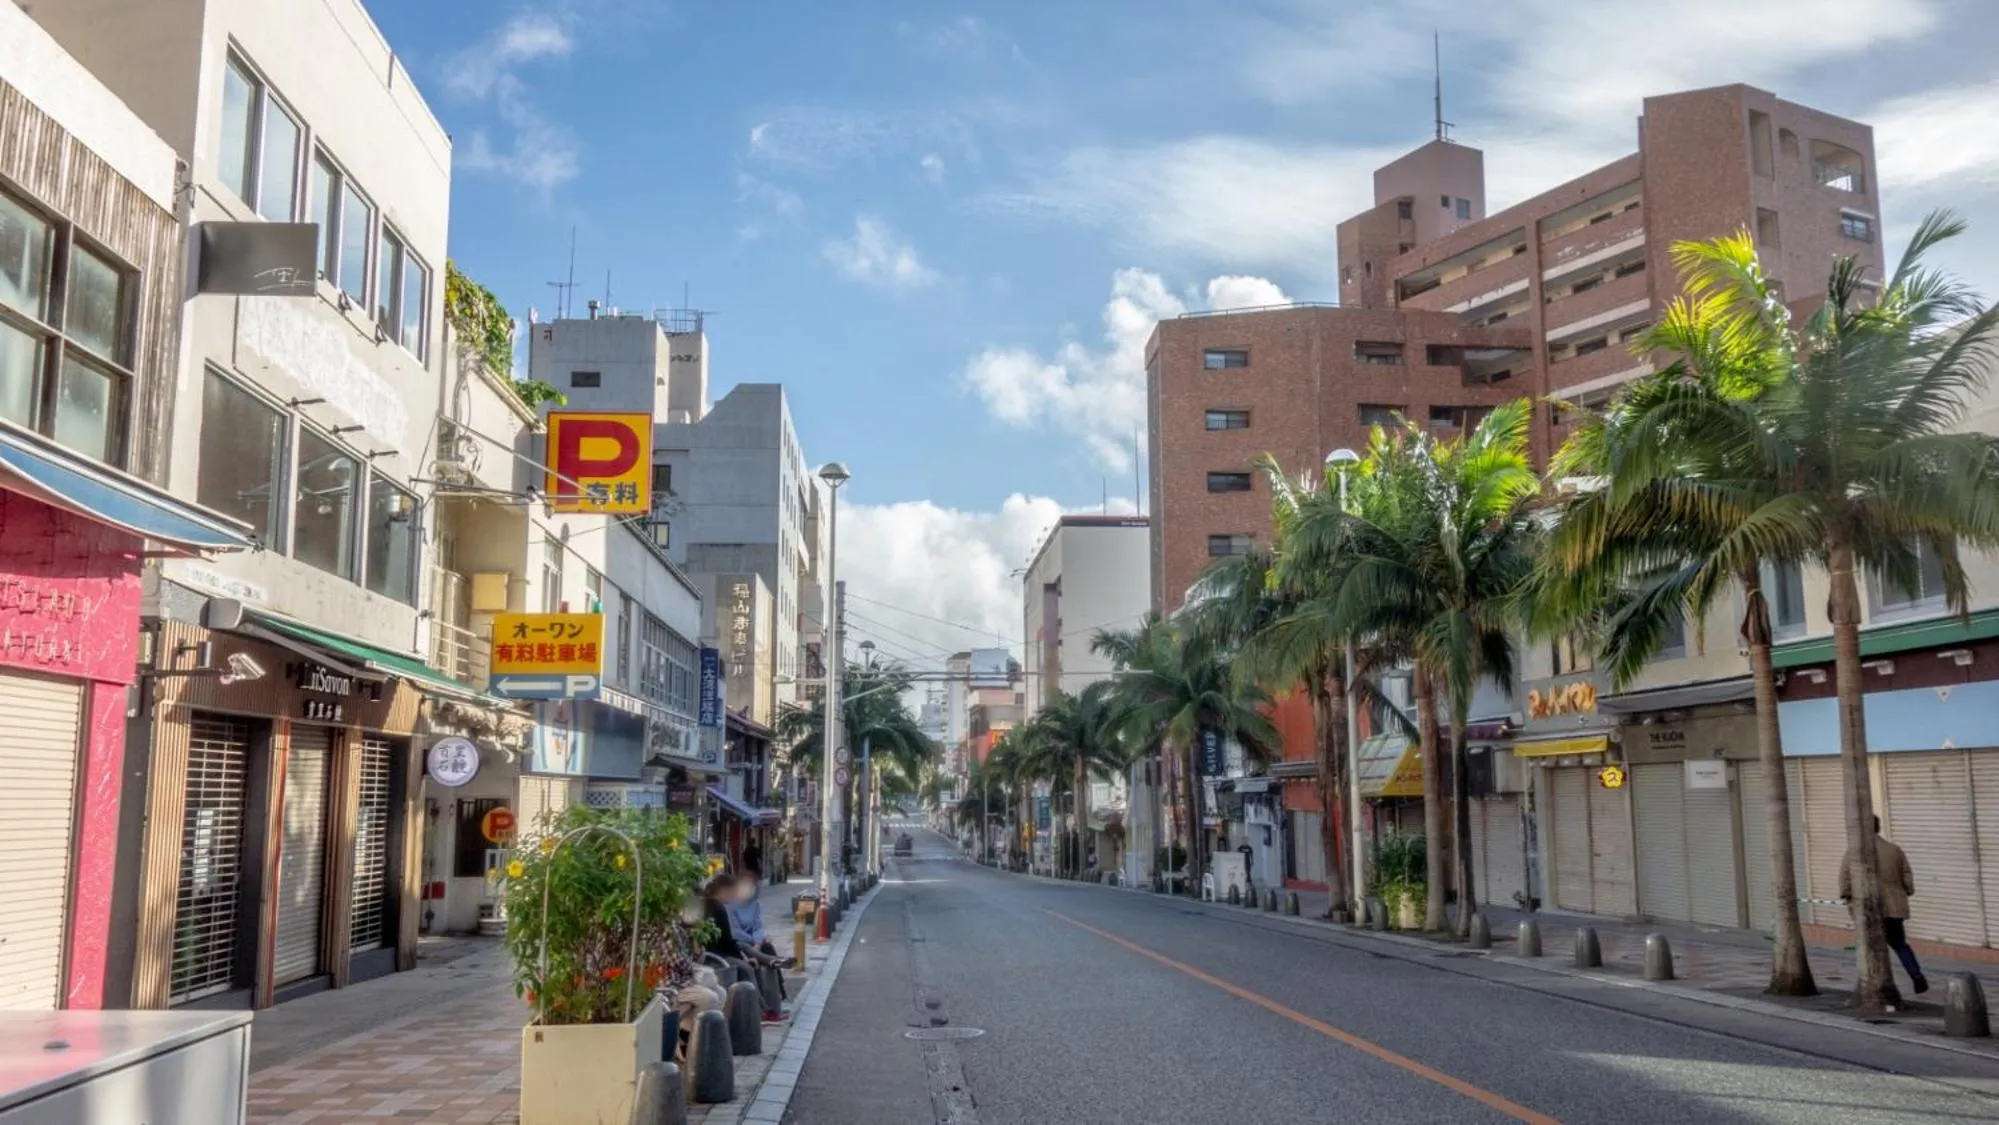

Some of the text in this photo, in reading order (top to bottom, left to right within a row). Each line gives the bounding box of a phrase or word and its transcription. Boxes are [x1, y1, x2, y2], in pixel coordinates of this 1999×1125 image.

[557, 420, 640, 505] P
[586, 482, 638, 505] 有料
[513, 622, 584, 639] オーワン
[495, 641, 598, 663] 有料駐車場
[565, 675, 597, 698] P
[489, 813, 514, 838] P
